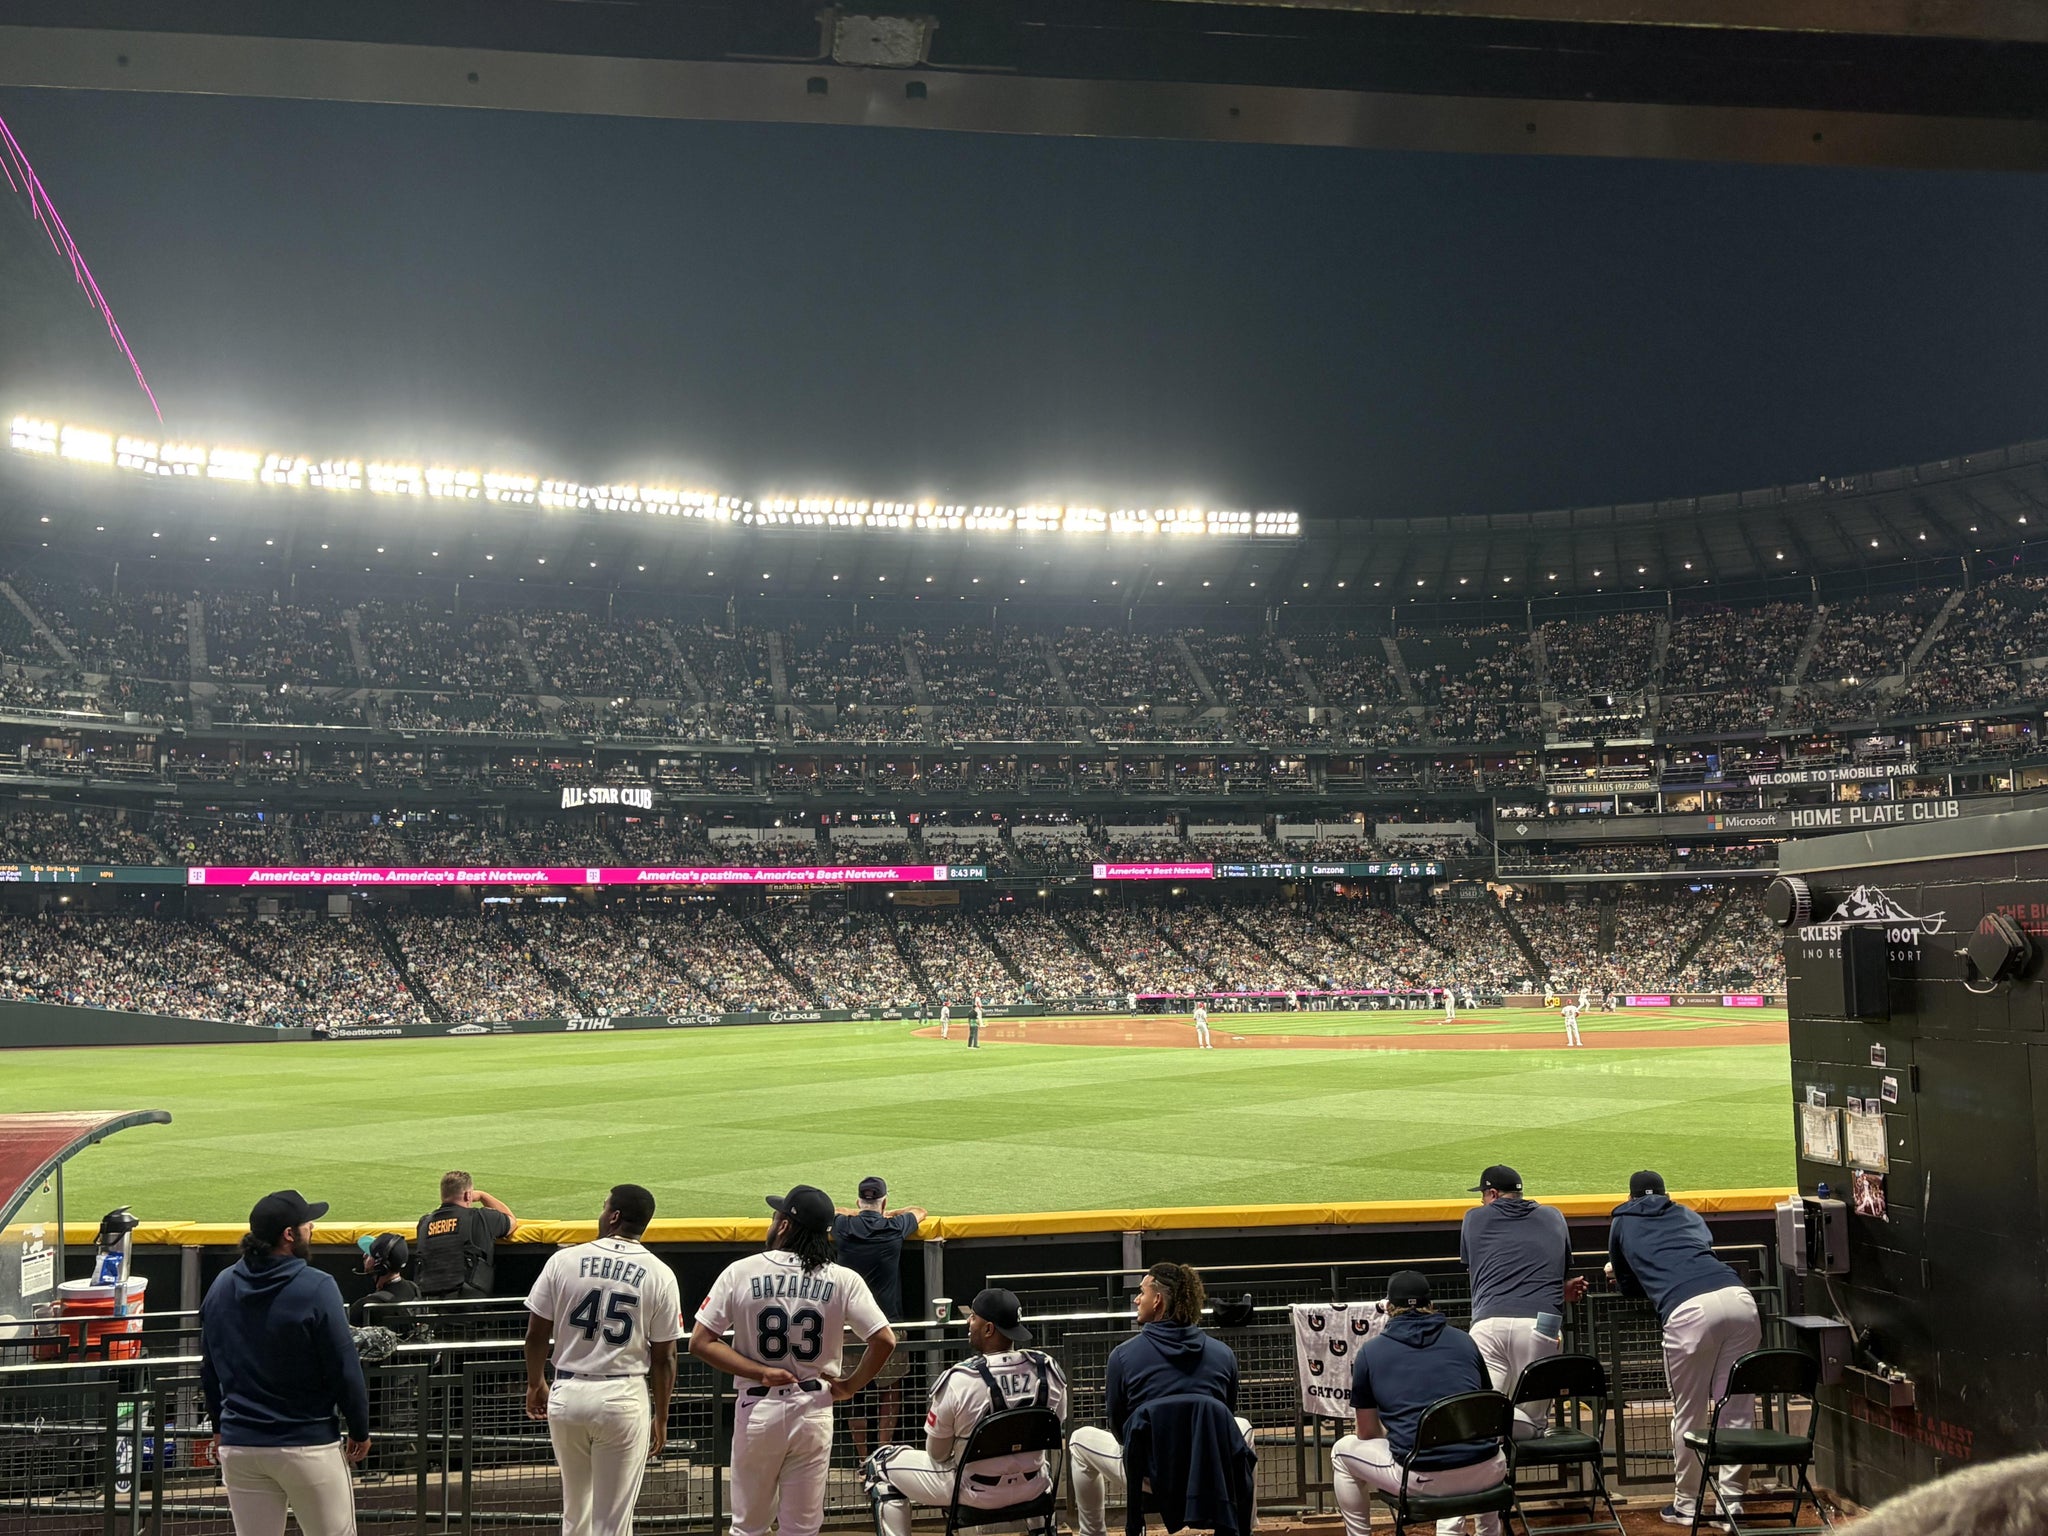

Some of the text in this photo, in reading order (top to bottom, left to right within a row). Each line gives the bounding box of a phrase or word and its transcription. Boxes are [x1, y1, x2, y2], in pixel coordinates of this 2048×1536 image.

[1749, 763, 1918, 786] WELCOME TO T-MOBILE PARK
[1556, 782, 1650, 793] DAVE NIEHAUS 1977-2010
[620, 788, 653, 810] CLUB
[1791, 800, 1959, 827] HOME PLATE CLUB
[1725, 814, 1777, 828] Microsoft
[249, 870, 549, 883] America's pastime. America's Best Network.
[637, 869, 899, 883] America's pastime. America's Best Network.
[950, 868, 983, 878] 8:43 PM
[1108, 866, 1211, 875] America's Best Network
[1262, 868, 1292, 877] 2 2 0
[1312, 866, 1345, 874] Canzone
[1368, 865, 1380, 874] RF
[1386, 866, 1437, 876] .257 19 56
[1996, 904, 2026, 919] THE
[667, 1014, 722, 1025] Great Clips
[783, 1012, 822, 1020] LEXUS
[566, 1018, 614, 1030] STIHL
[428, 1218, 458, 1236] SHERIFF
[579, 1255, 647, 1289] FERRER
[751, 1273, 835, 1304] BAZARDO
[568, 1287, 641, 1347] 45
[757, 1306, 824, 1362] 83
[1940, 1420, 1975, 1445] BEST
